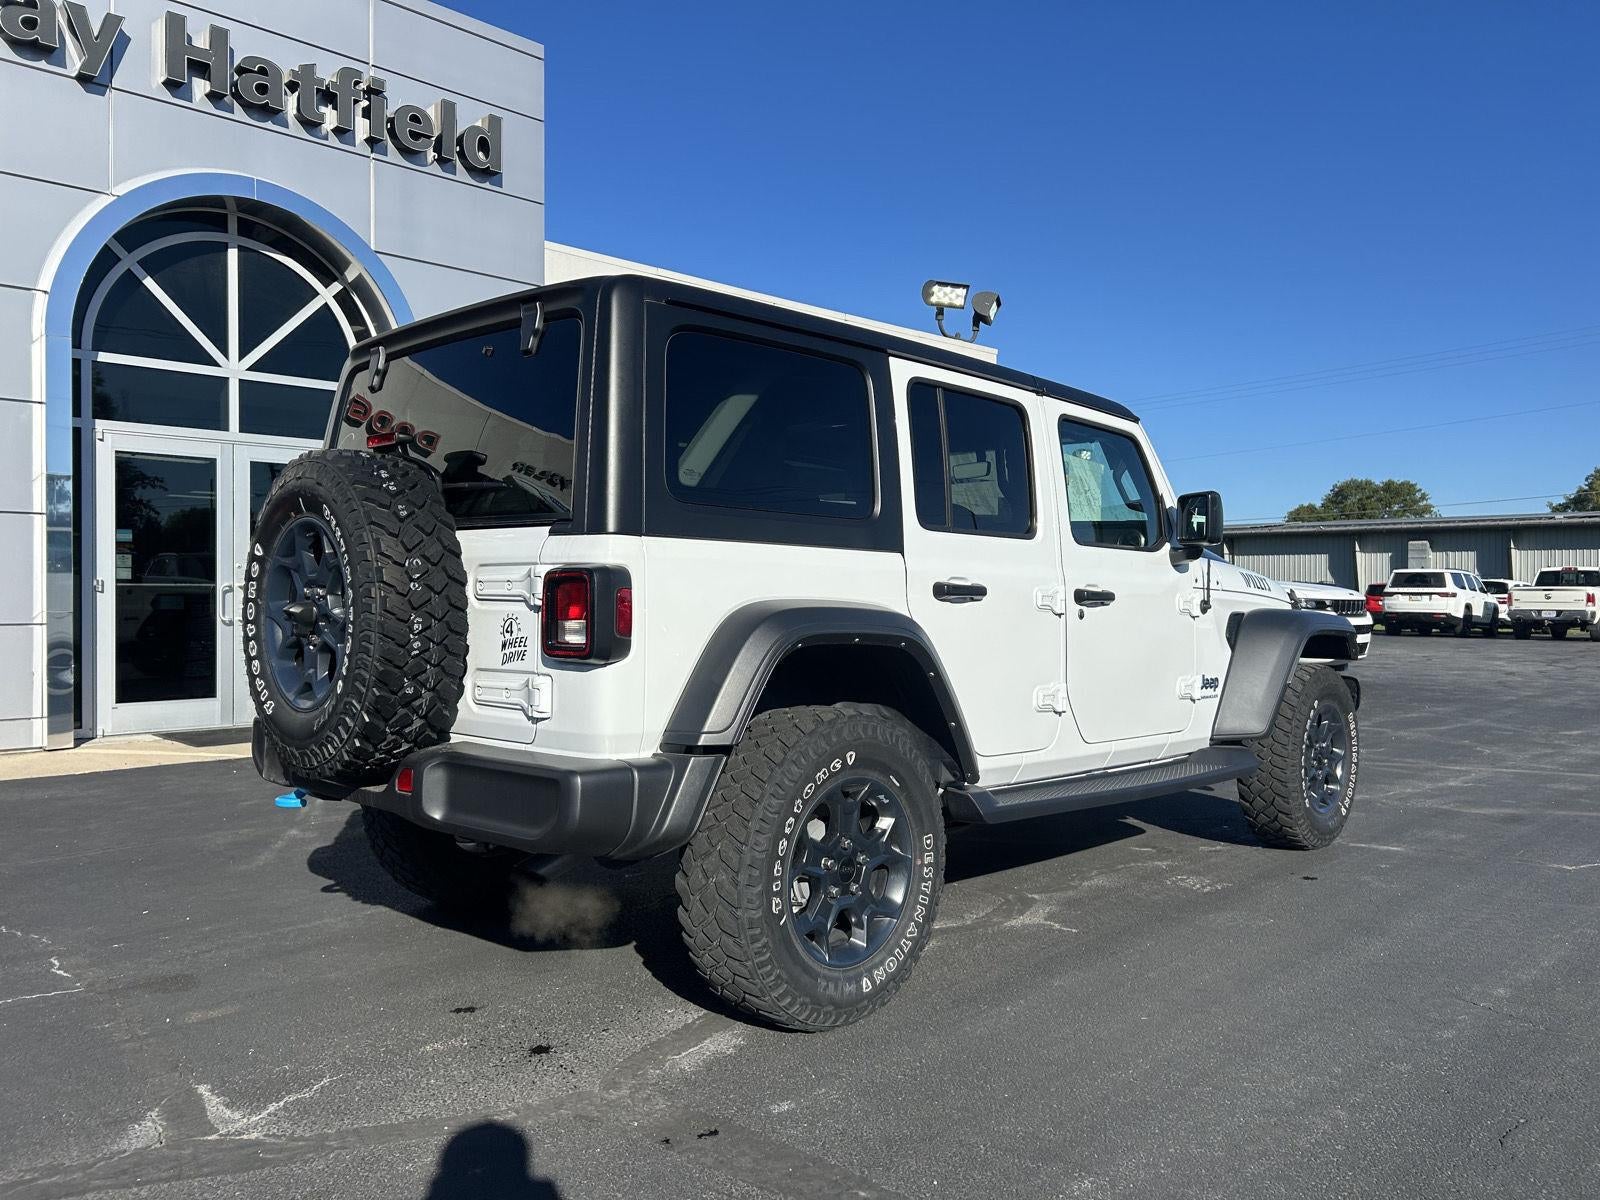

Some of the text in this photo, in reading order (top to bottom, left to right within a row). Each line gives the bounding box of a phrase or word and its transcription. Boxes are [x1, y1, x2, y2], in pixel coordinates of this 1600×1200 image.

[163, 10, 504, 174] Hatfield
[504, 619, 514, 638] 4
[501, 636, 528, 652] WHEEL
[501, 650, 528, 666] DRIVE
[1200, 674, 1219, 692] Jeep
[874, 833, 934, 984] DESTINATION
